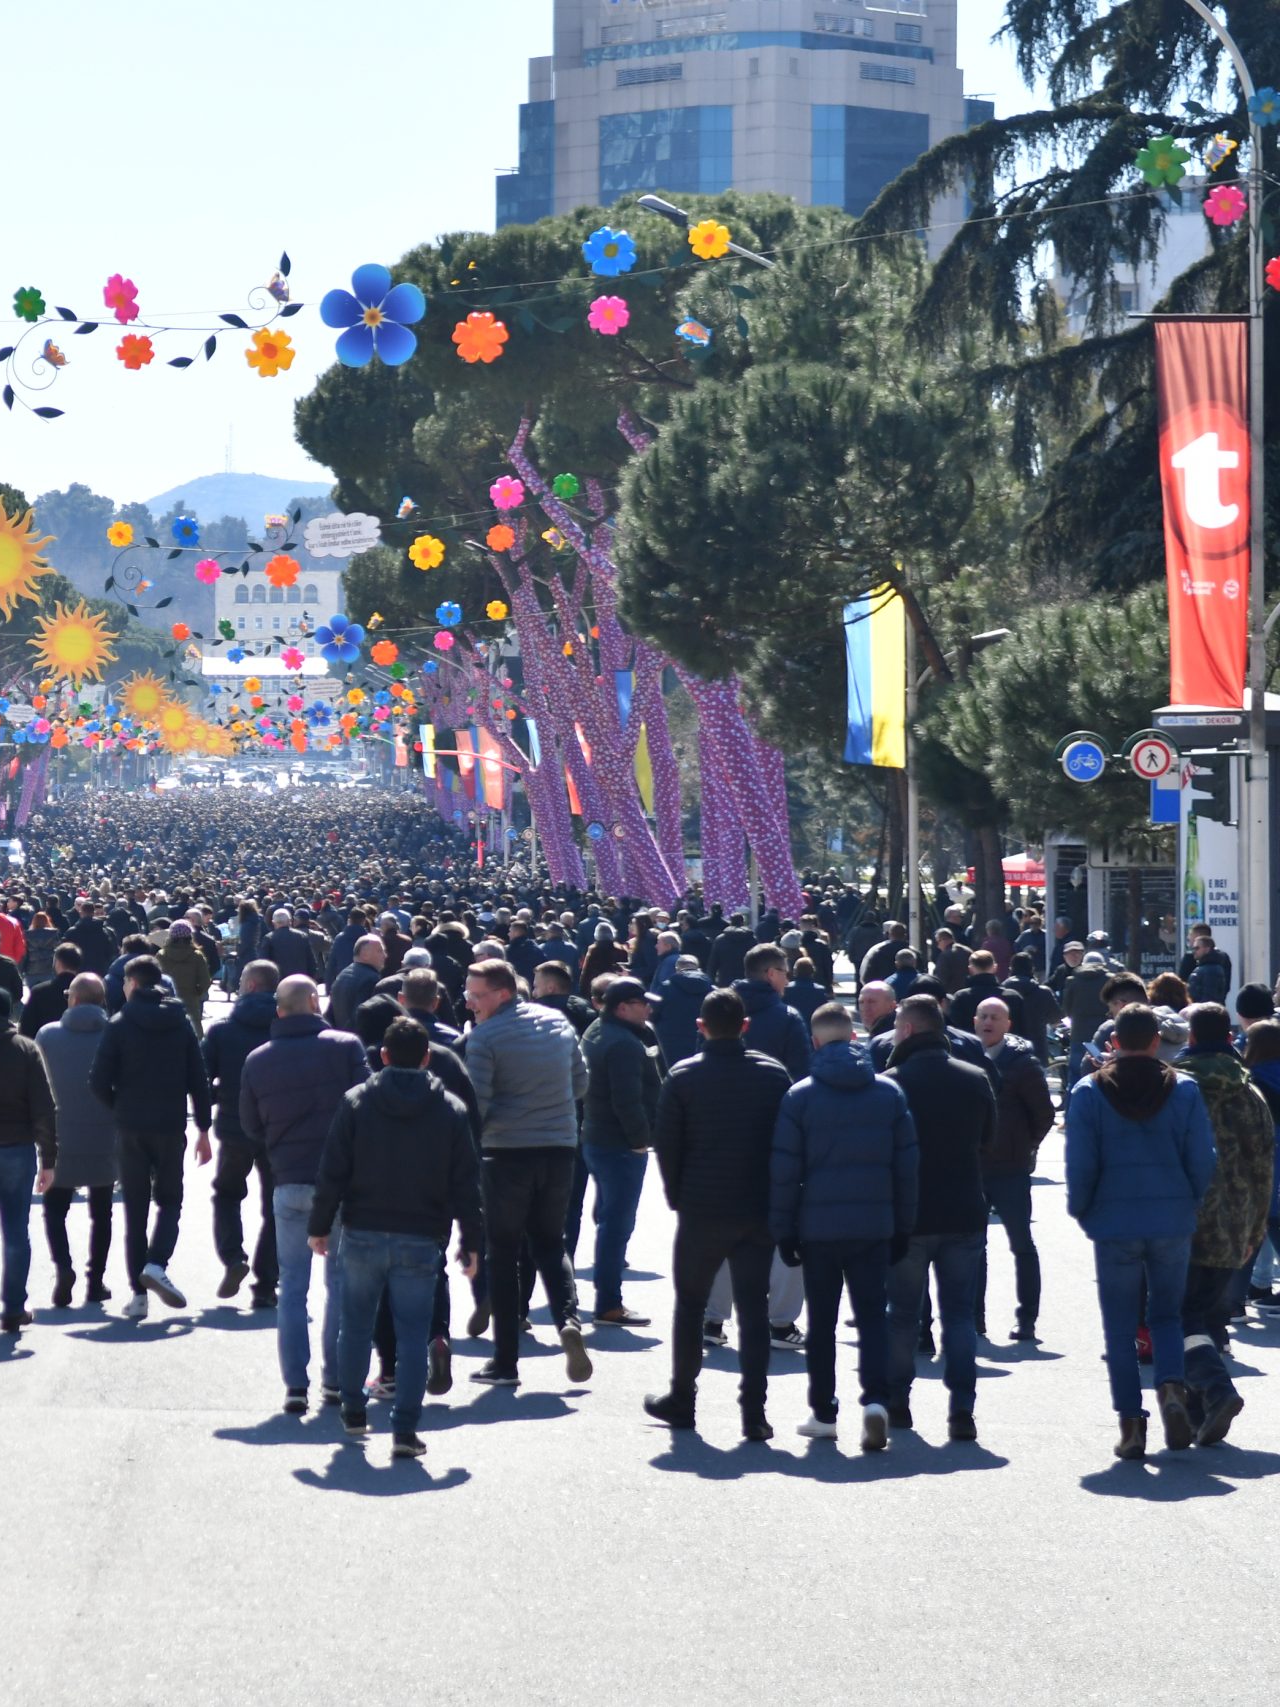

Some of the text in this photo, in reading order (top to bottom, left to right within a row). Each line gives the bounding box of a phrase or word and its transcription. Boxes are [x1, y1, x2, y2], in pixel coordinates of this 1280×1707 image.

[1171, 432, 1239, 529] t
[1208, 904, 1239, 914] PROVO
[1208, 917, 1238, 927] HEINEK
